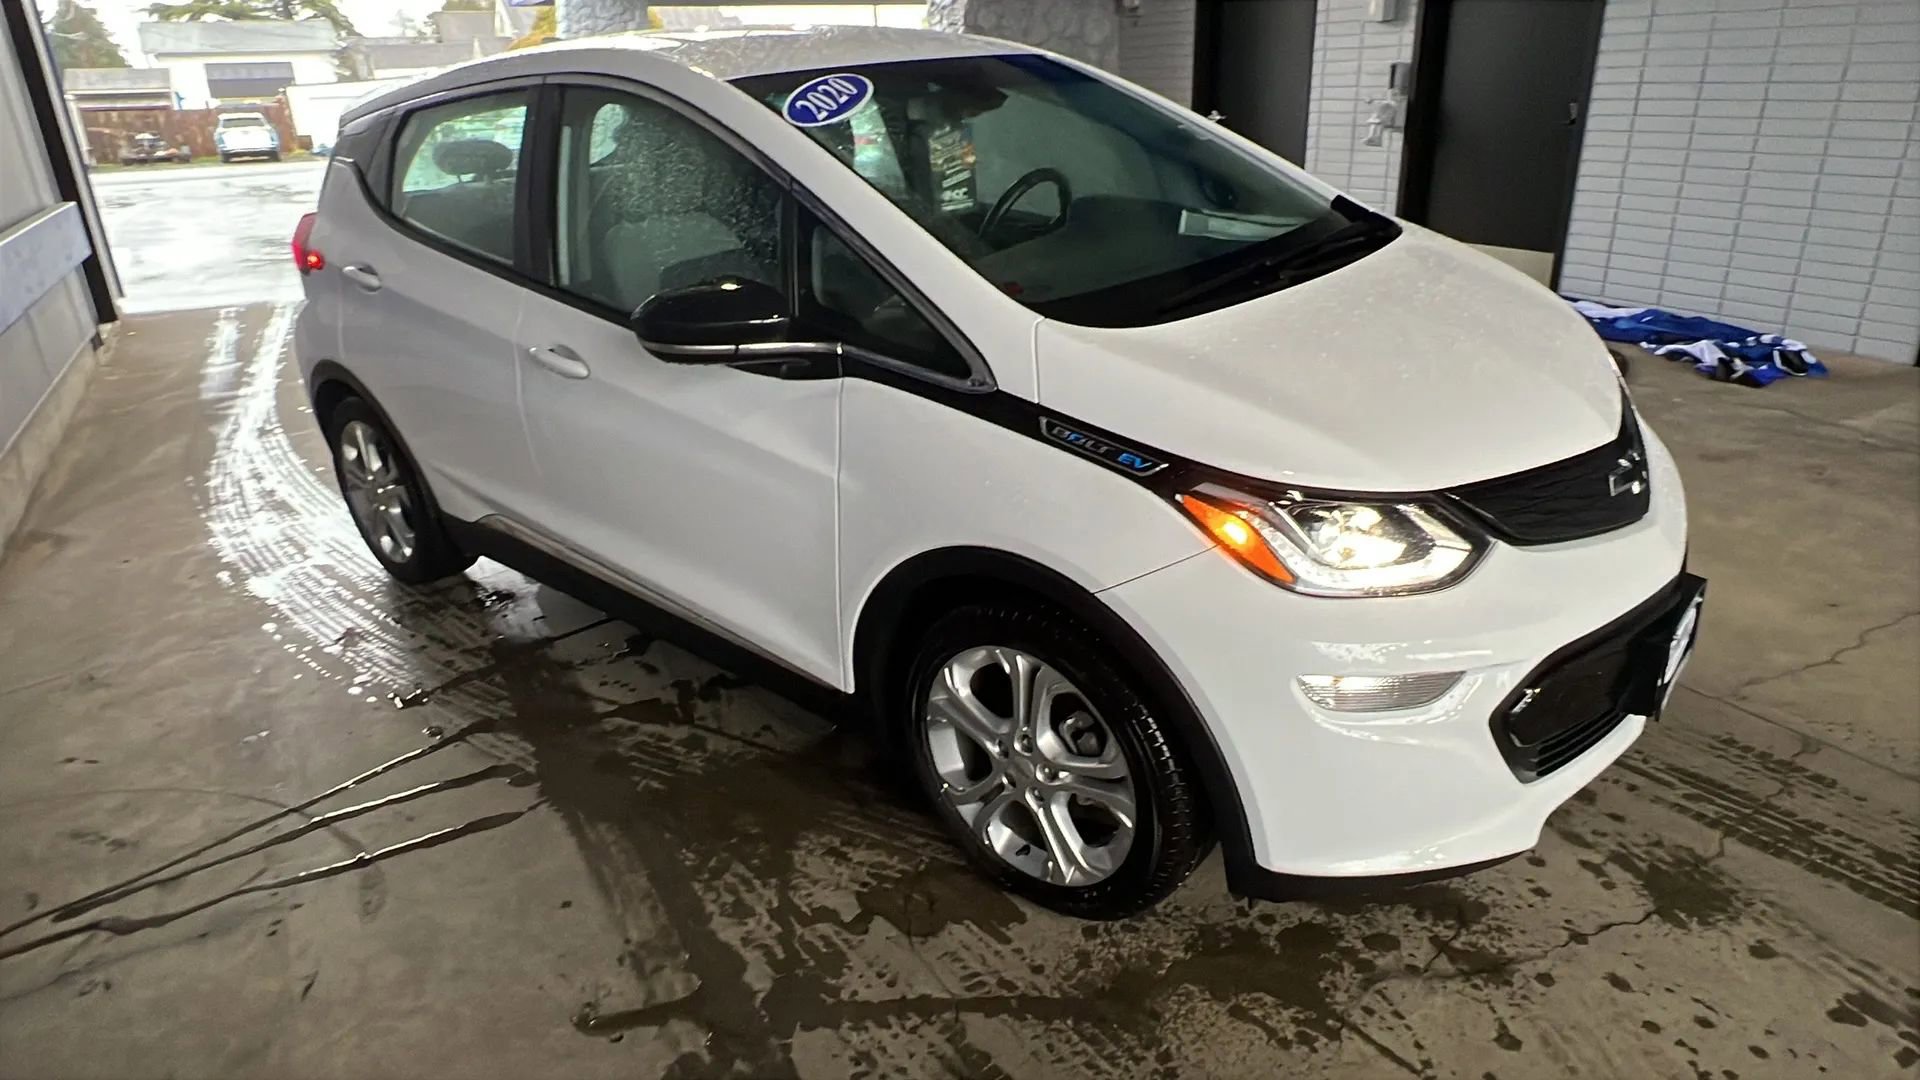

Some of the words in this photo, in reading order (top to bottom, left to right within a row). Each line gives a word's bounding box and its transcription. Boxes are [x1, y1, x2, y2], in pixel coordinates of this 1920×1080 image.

[795, 78, 858, 121] 2020
[1051, 426, 1117, 454] BOLT
[1117, 452, 1153, 469] EV
